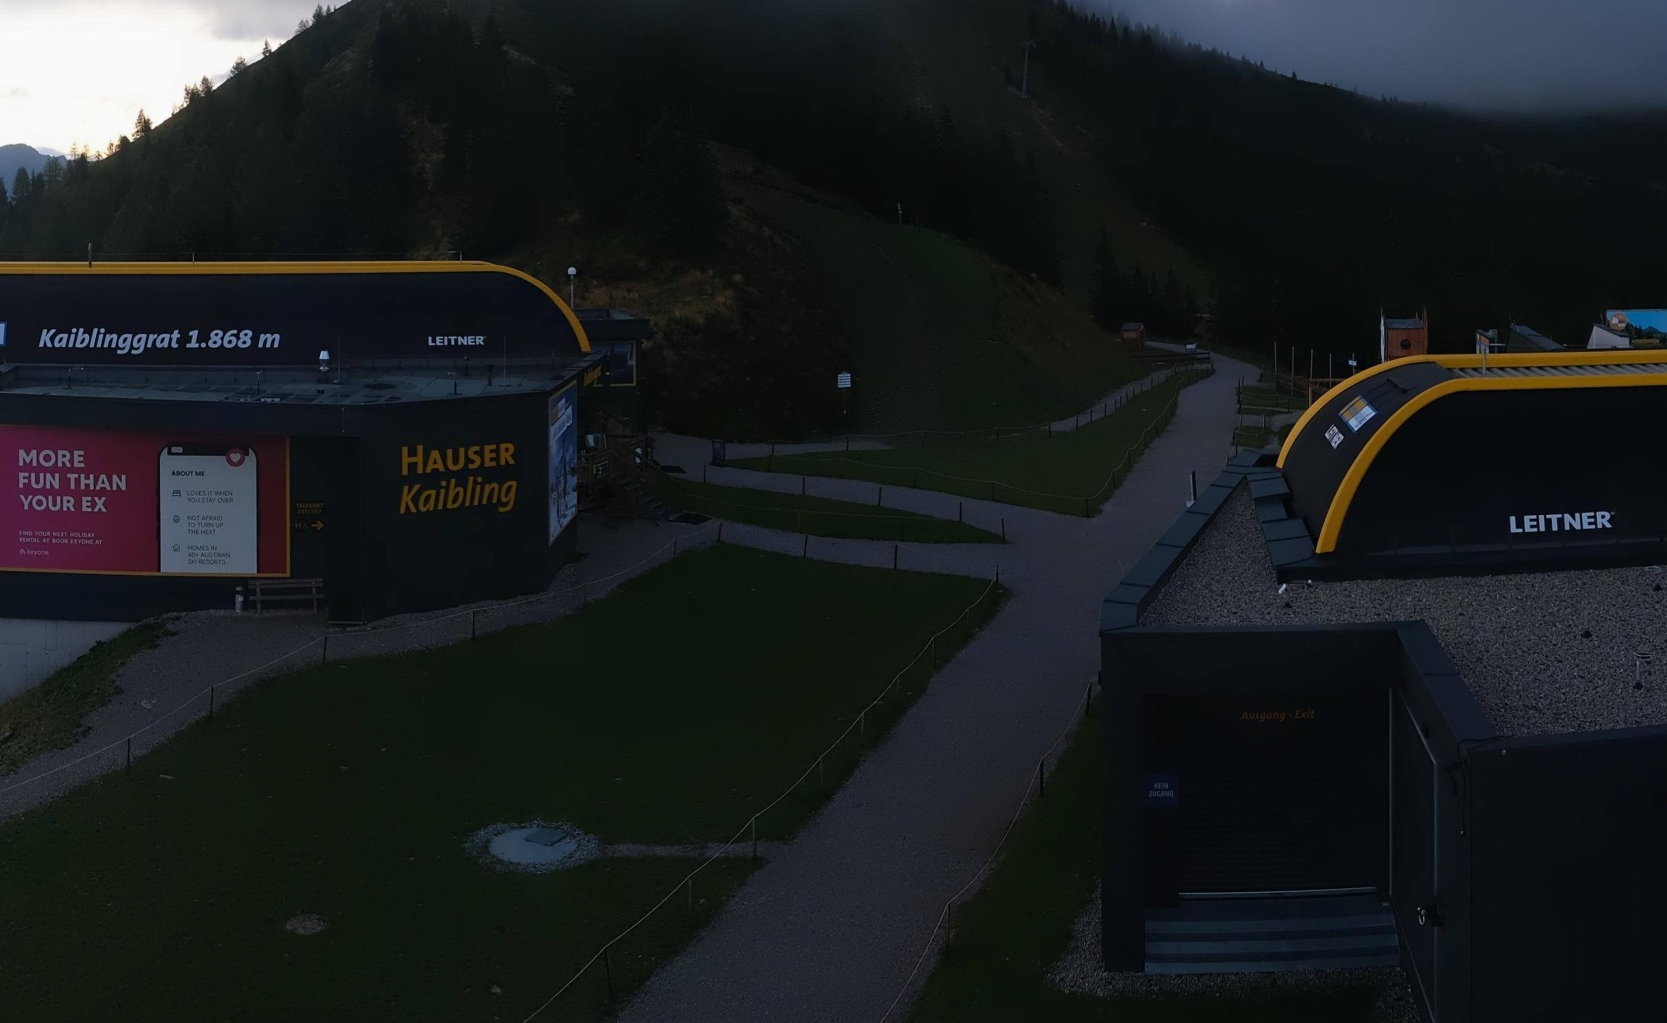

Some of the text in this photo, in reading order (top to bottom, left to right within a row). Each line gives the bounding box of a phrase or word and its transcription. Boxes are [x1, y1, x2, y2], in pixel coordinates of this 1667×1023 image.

[38, 328, 280, 355] Kaiblinggrat 1.868 m
[427, 336, 485, 346] LEITNER
[18, 449, 85, 468] MORE
[401, 442, 516, 476] HAUSER
[18, 472, 127, 491] FUN THAN
[20, 495, 107, 513] YOUR EX
[399, 476, 518, 514] Kaibling
[1509, 511, 1613, 533] LEITNER
[27, 548, 49, 556] keyone
[1241, 710, 1286, 722] Ausgang
[1295, 709, 1315, 720] Exit
[1148, 790, 1175, 798] ZUGANG
